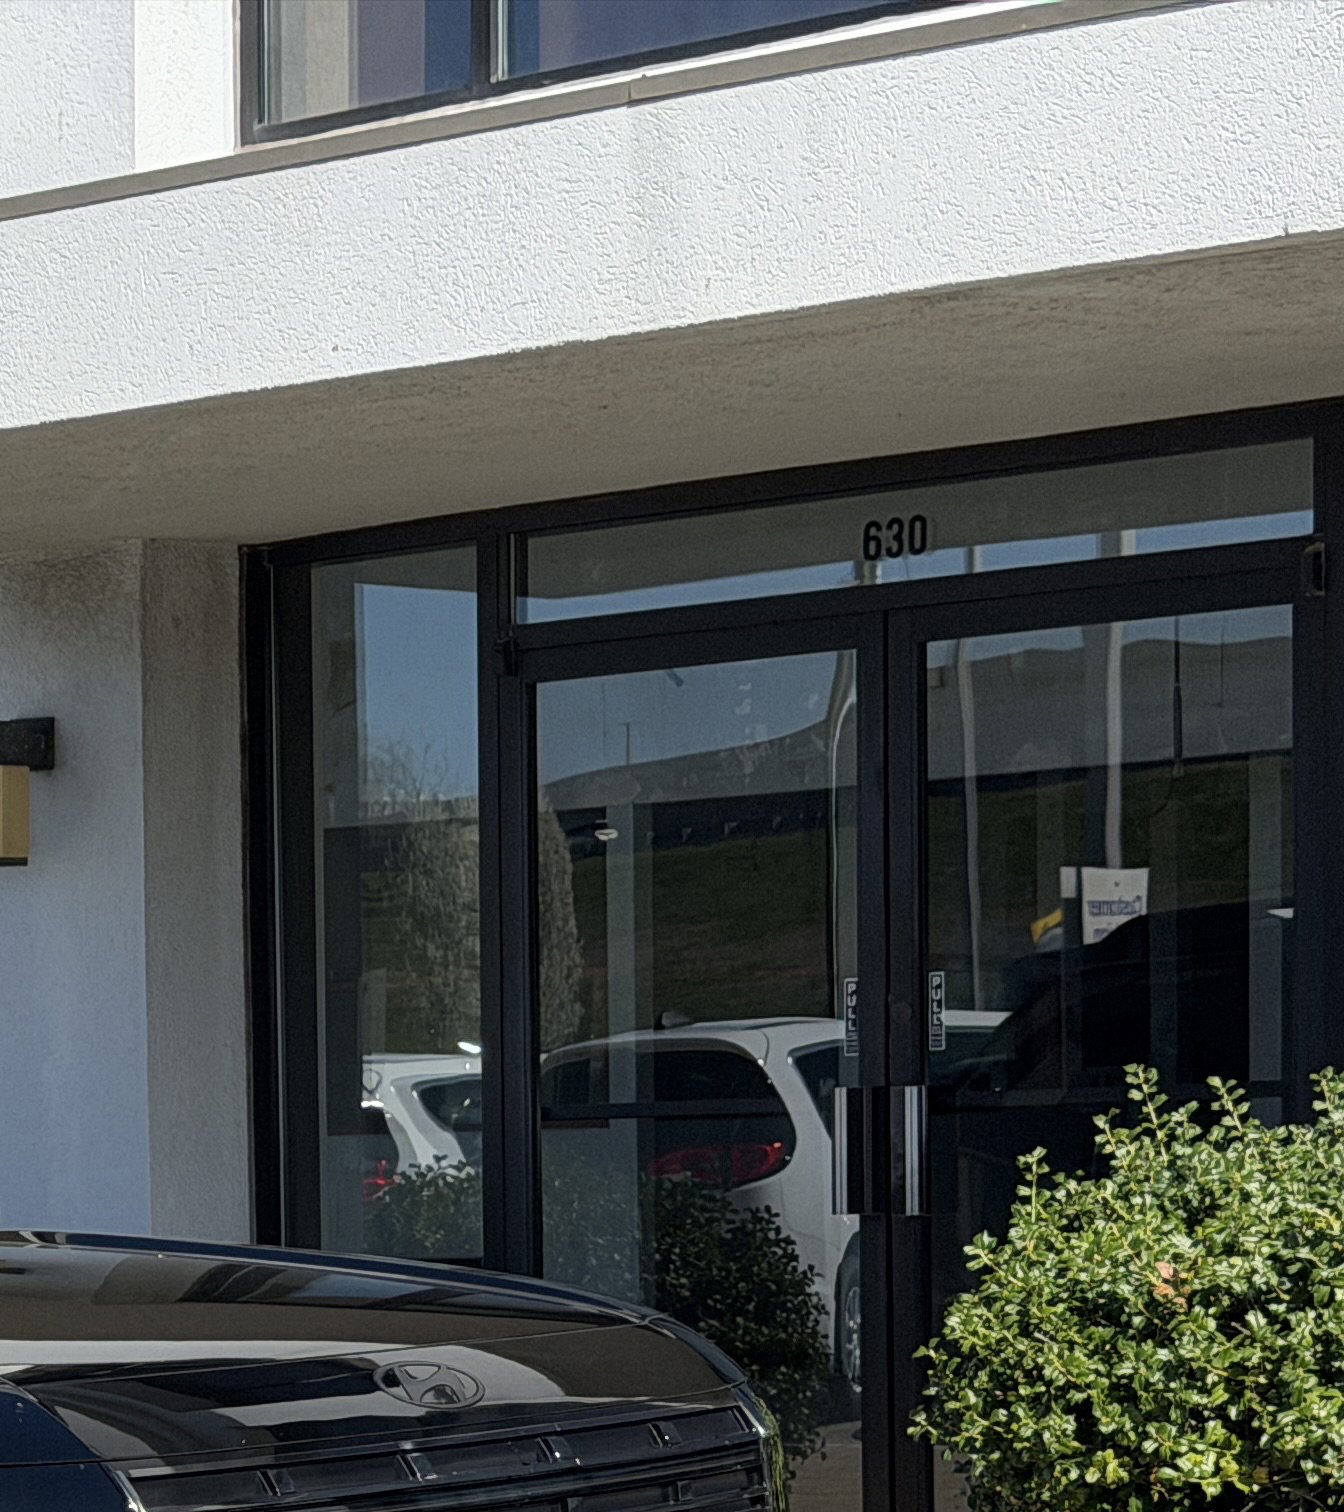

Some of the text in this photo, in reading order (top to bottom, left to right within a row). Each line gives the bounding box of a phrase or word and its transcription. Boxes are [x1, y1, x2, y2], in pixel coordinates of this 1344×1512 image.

[863, 514, 928, 561] 630
[847, 983, 857, 1031] PULL
[931, 976, 941, 1025] PULL
